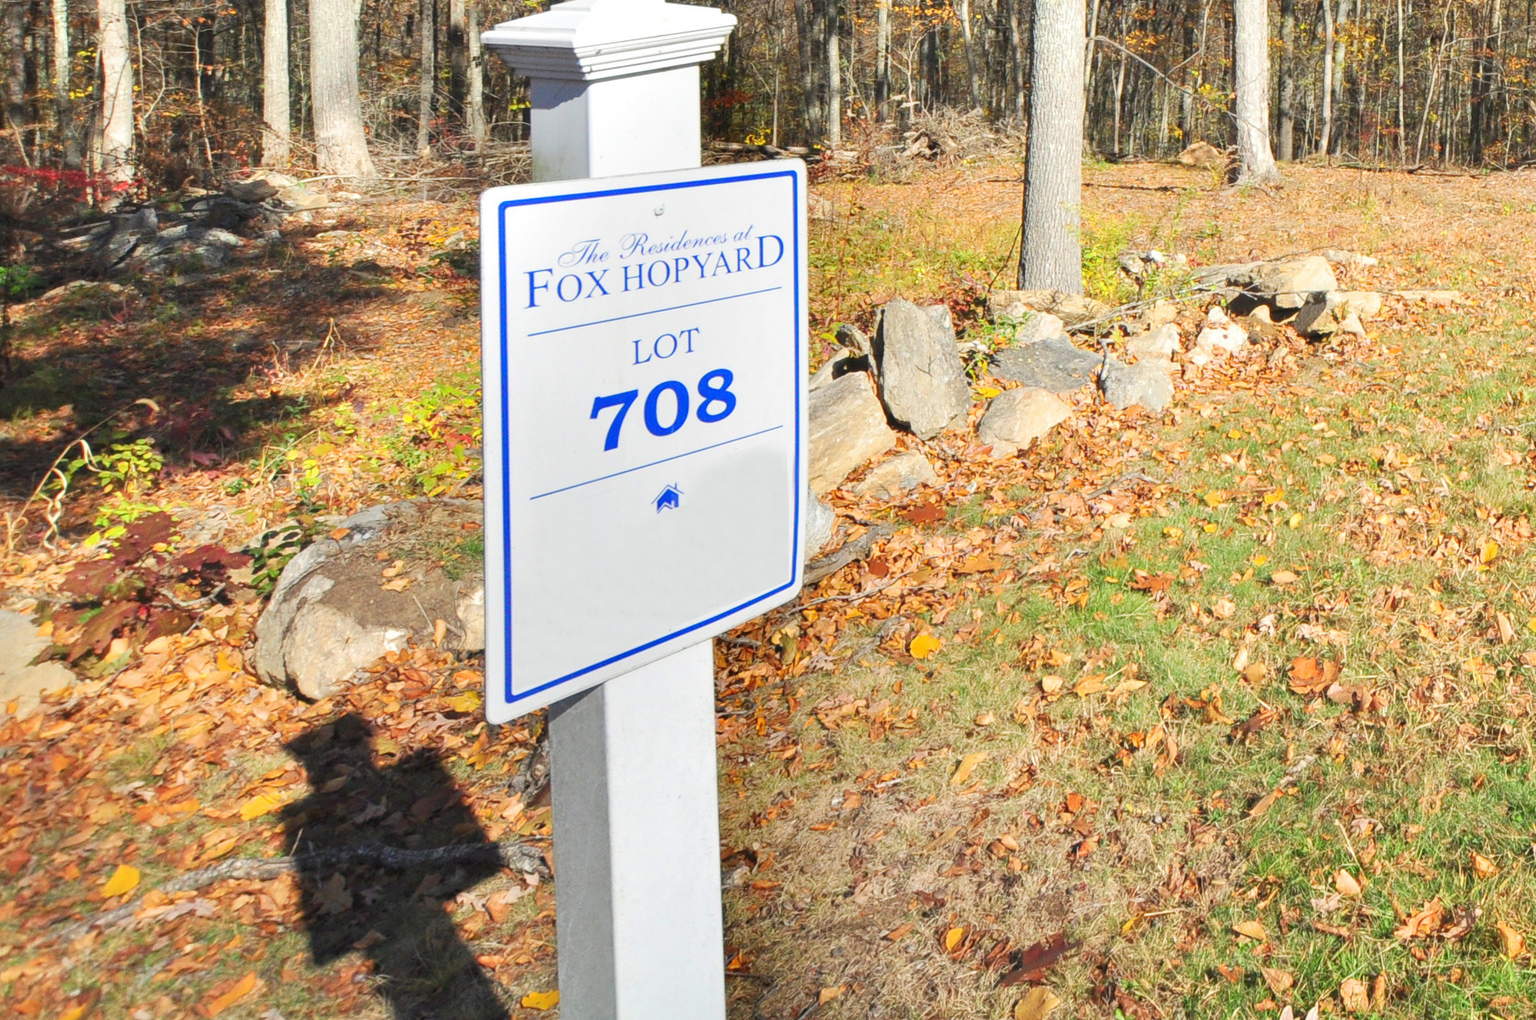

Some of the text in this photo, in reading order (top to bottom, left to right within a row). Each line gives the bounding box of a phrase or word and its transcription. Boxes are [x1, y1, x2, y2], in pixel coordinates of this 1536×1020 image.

[523, 234, 785, 309] FOX HOPYARD
[557, 224, 754, 268] The Residences at
[631, 327, 700, 365] LOT
[589, 368, 737, 452] 708
